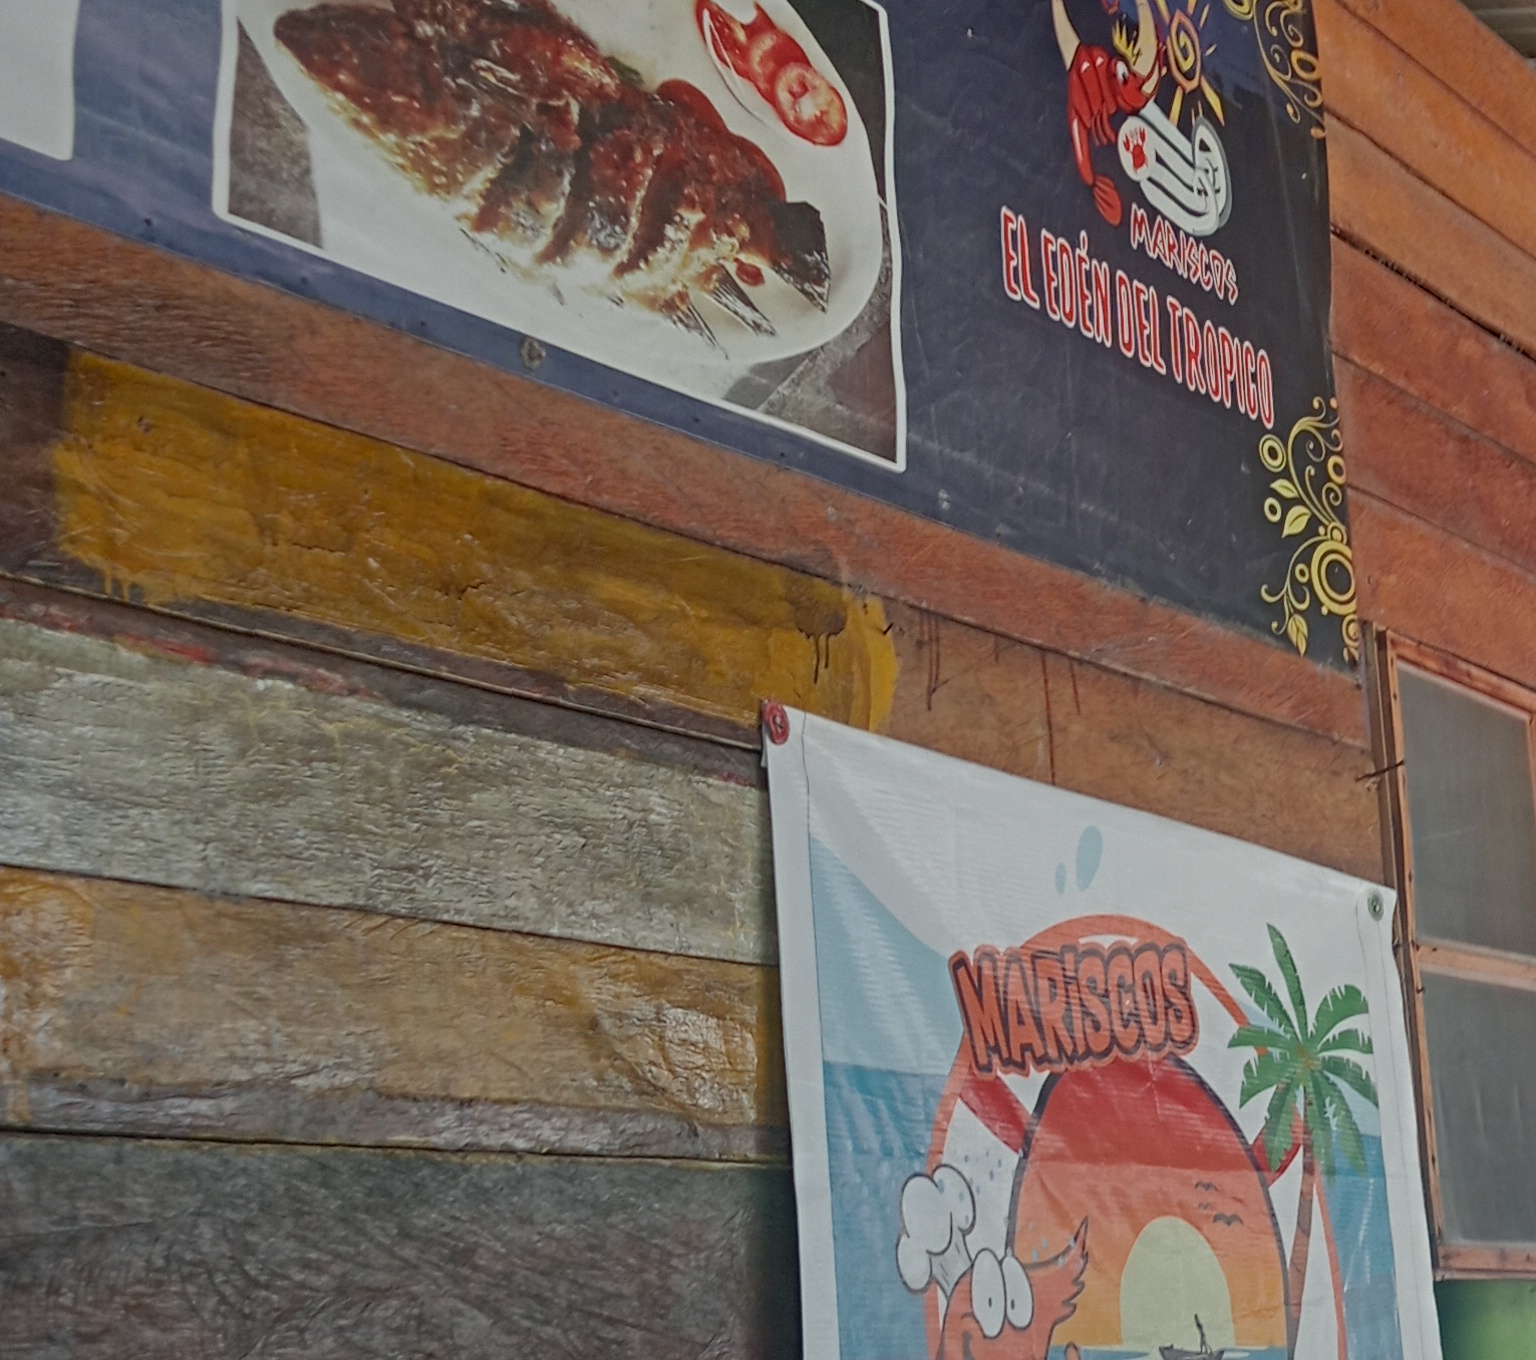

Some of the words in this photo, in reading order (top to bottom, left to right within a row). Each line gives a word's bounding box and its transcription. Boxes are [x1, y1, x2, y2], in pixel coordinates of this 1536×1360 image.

[1001, 205, 1040, 309] EL
[1041, 229, 1111, 348] EDÉN
[1116, 270, 1166, 375] DEL
[1167, 295, 1274, 431] TROPICO
[1130, 202, 1239, 305] MARISCOS
